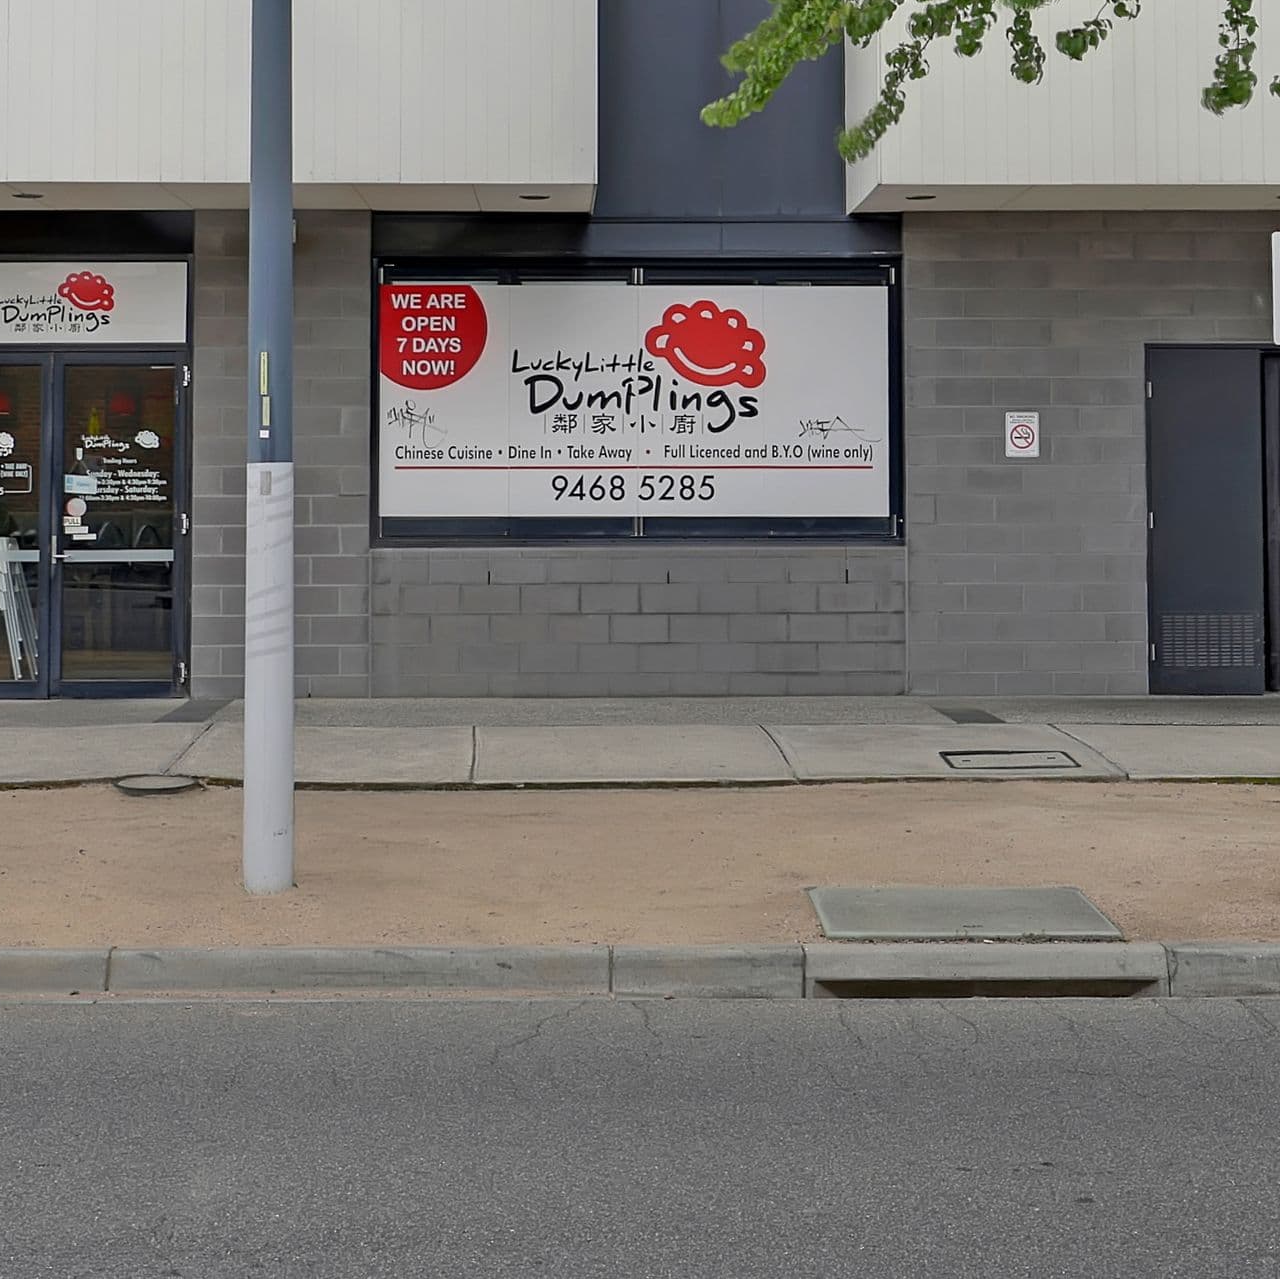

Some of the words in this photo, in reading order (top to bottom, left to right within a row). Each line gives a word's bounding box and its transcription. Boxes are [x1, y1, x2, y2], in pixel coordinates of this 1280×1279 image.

[391, 293, 422, 309] WE
[426, 293, 466, 309] ARE
[401, 316, 456, 332] OPEN
[396, 337, 408, 353] 7
[412, 337, 461, 353] DAYS
[402, 360, 455, 376] NOW!
[395, 445, 444, 460] Chinese
[448, 445, 493, 460] Cuisine
[508, 445, 536, 459] Dine
[540, 445, 552, 459] In
[567, 445, 595, 459] Take
[598, 445, 632, 462] Away
[664, 445, 686, 459] Full
[690, 445, 741, 459] Licenced
[744, 445, 767, 459] and
[772, 445, 803, 459] B.Y.O
[807, 445, 840, 462] (wine
[844, 445, 874, 462] only)
[551, 474, 625, 501] 9468
[637, 474, 715, 501] 5285
